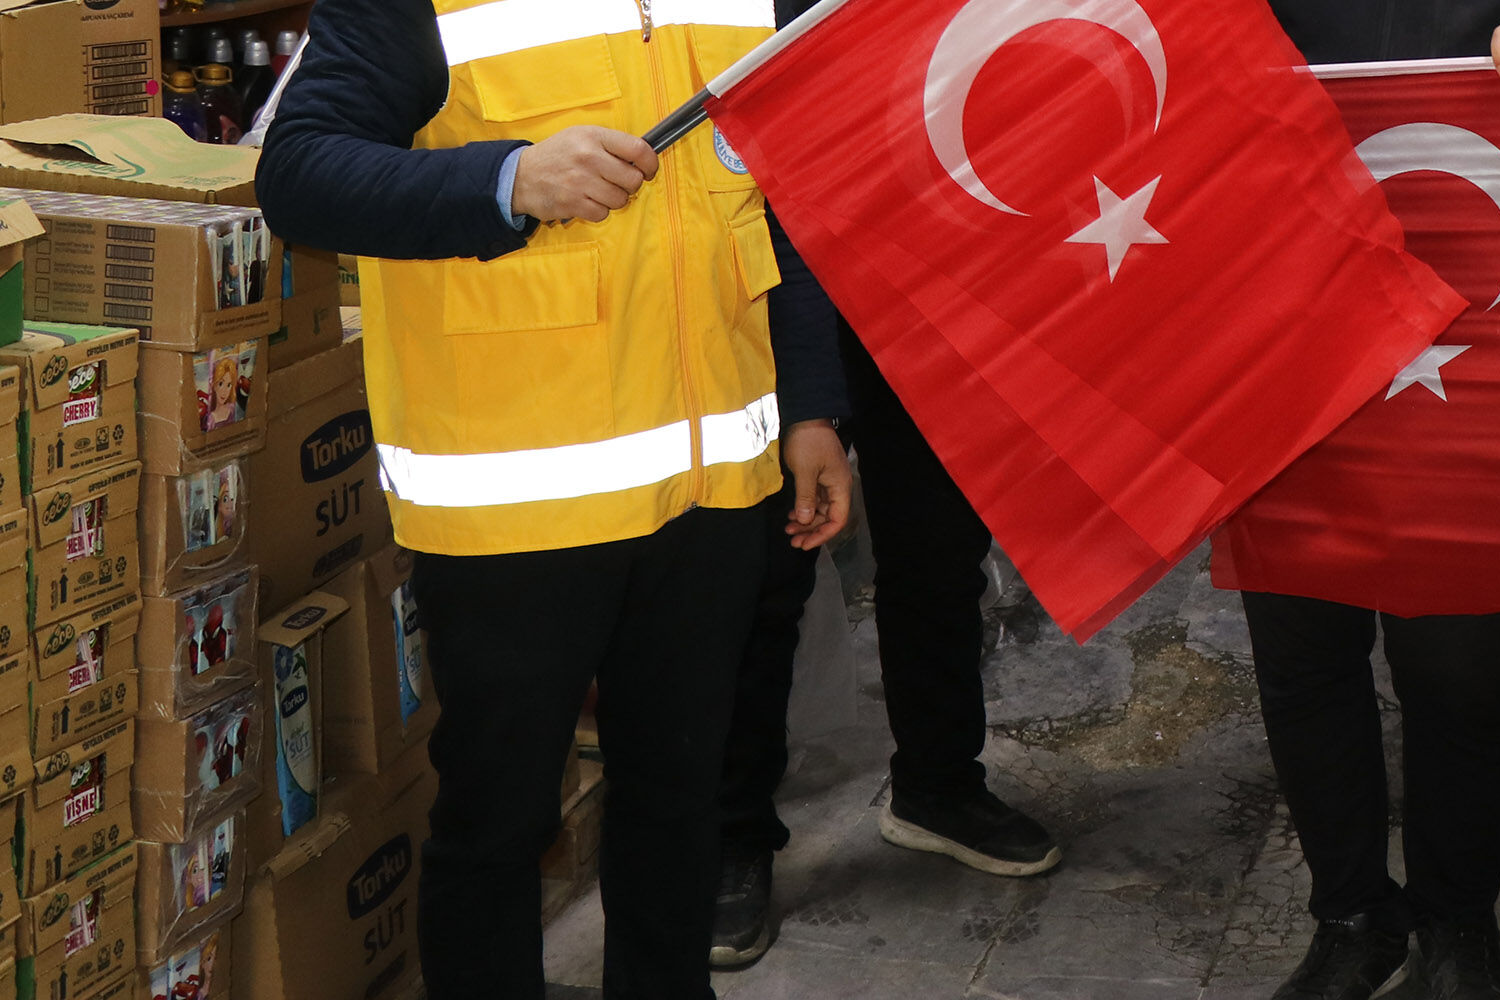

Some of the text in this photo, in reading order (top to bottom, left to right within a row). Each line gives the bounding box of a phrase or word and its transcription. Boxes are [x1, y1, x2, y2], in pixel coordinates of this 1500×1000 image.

[64, 401, 97, 422] CHERRY
[306, 425, 366, 471] Torku
[316, 479, 364, 537] SÜT
[283, 691, 306, 712] Torku
[353, 850, 405, 905] Torku
